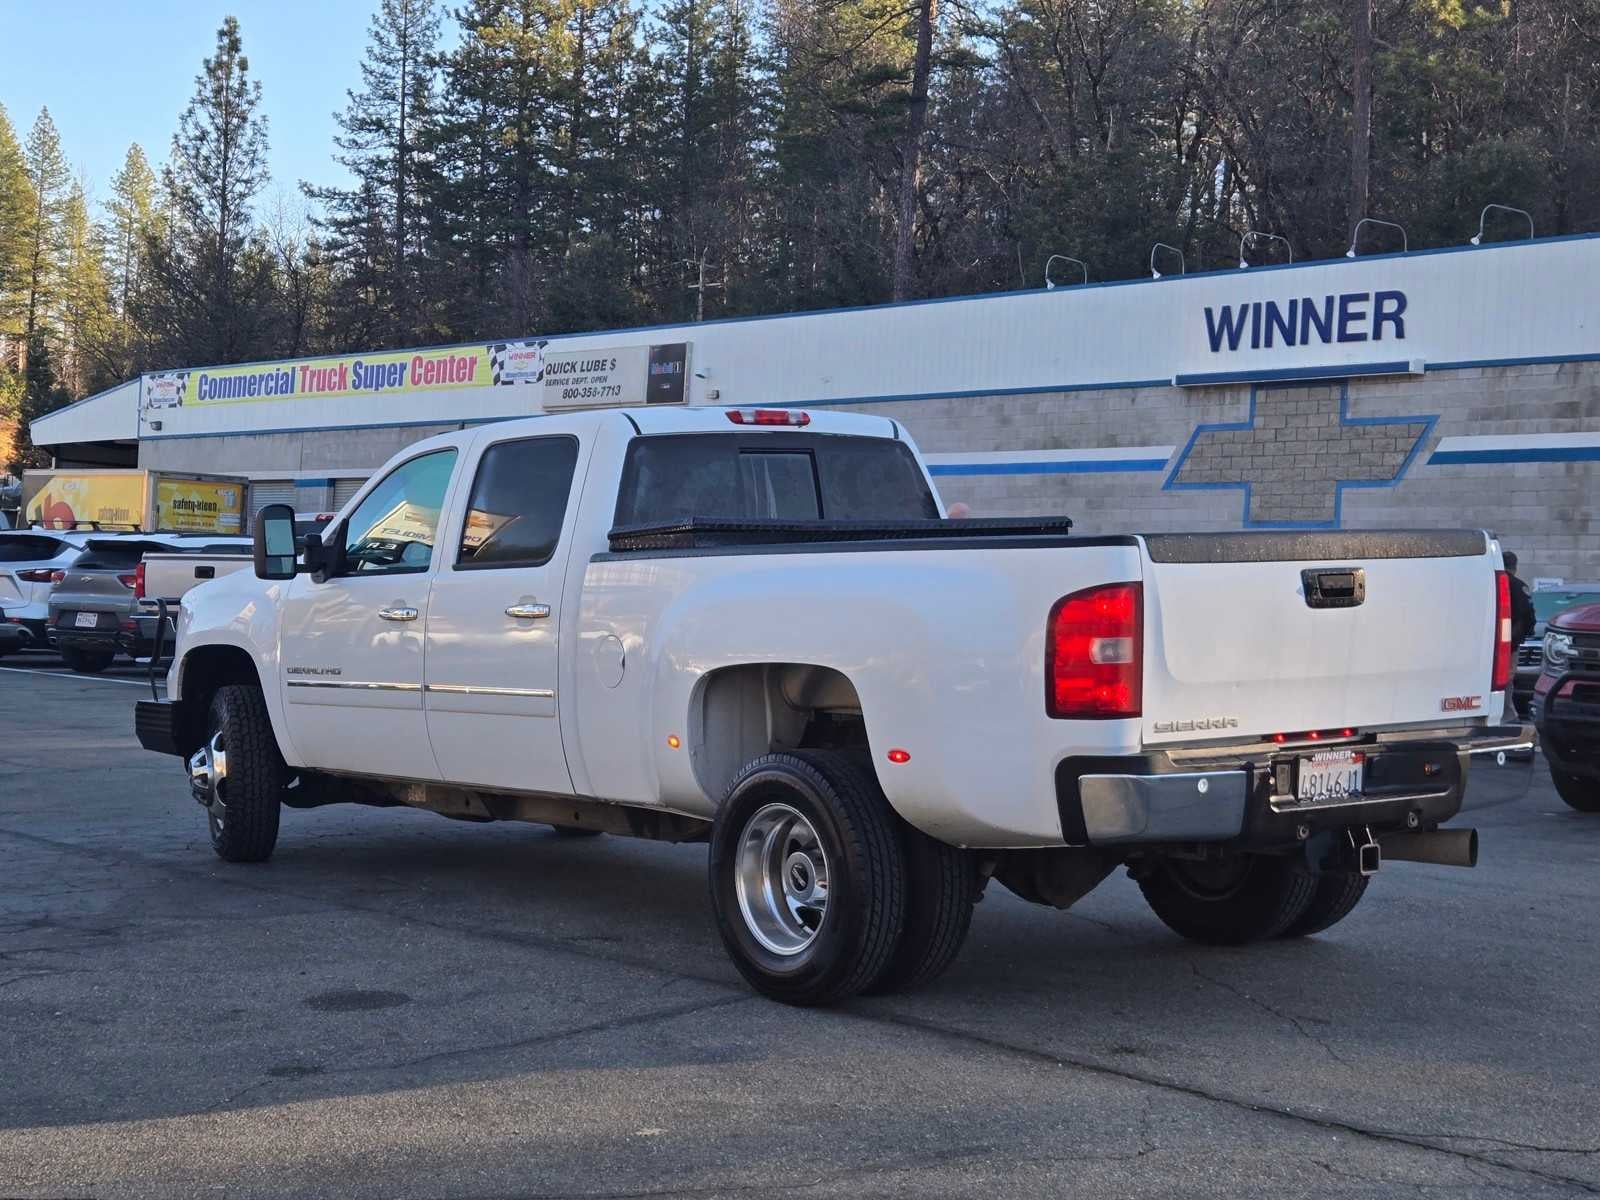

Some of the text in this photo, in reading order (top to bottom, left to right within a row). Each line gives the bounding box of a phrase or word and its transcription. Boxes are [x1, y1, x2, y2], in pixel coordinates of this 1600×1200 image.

[1203, 290, 1408, 352] WINNER
[545, 361, 577, 376] QUICK
[579, 359, 608, 373] LUBE
[197, 354, 478, 401] Commercial Truck Super Center
[545, 375, 608, 387] SERVICE DEPT. OPEN
[1441, 696, 1481, 712] GMC
[1153, 717, 1238, 733] SIERRA
[1314, 750, 1352, 762] WINNER
[1301, 770, 1359, 797] 48146J1
